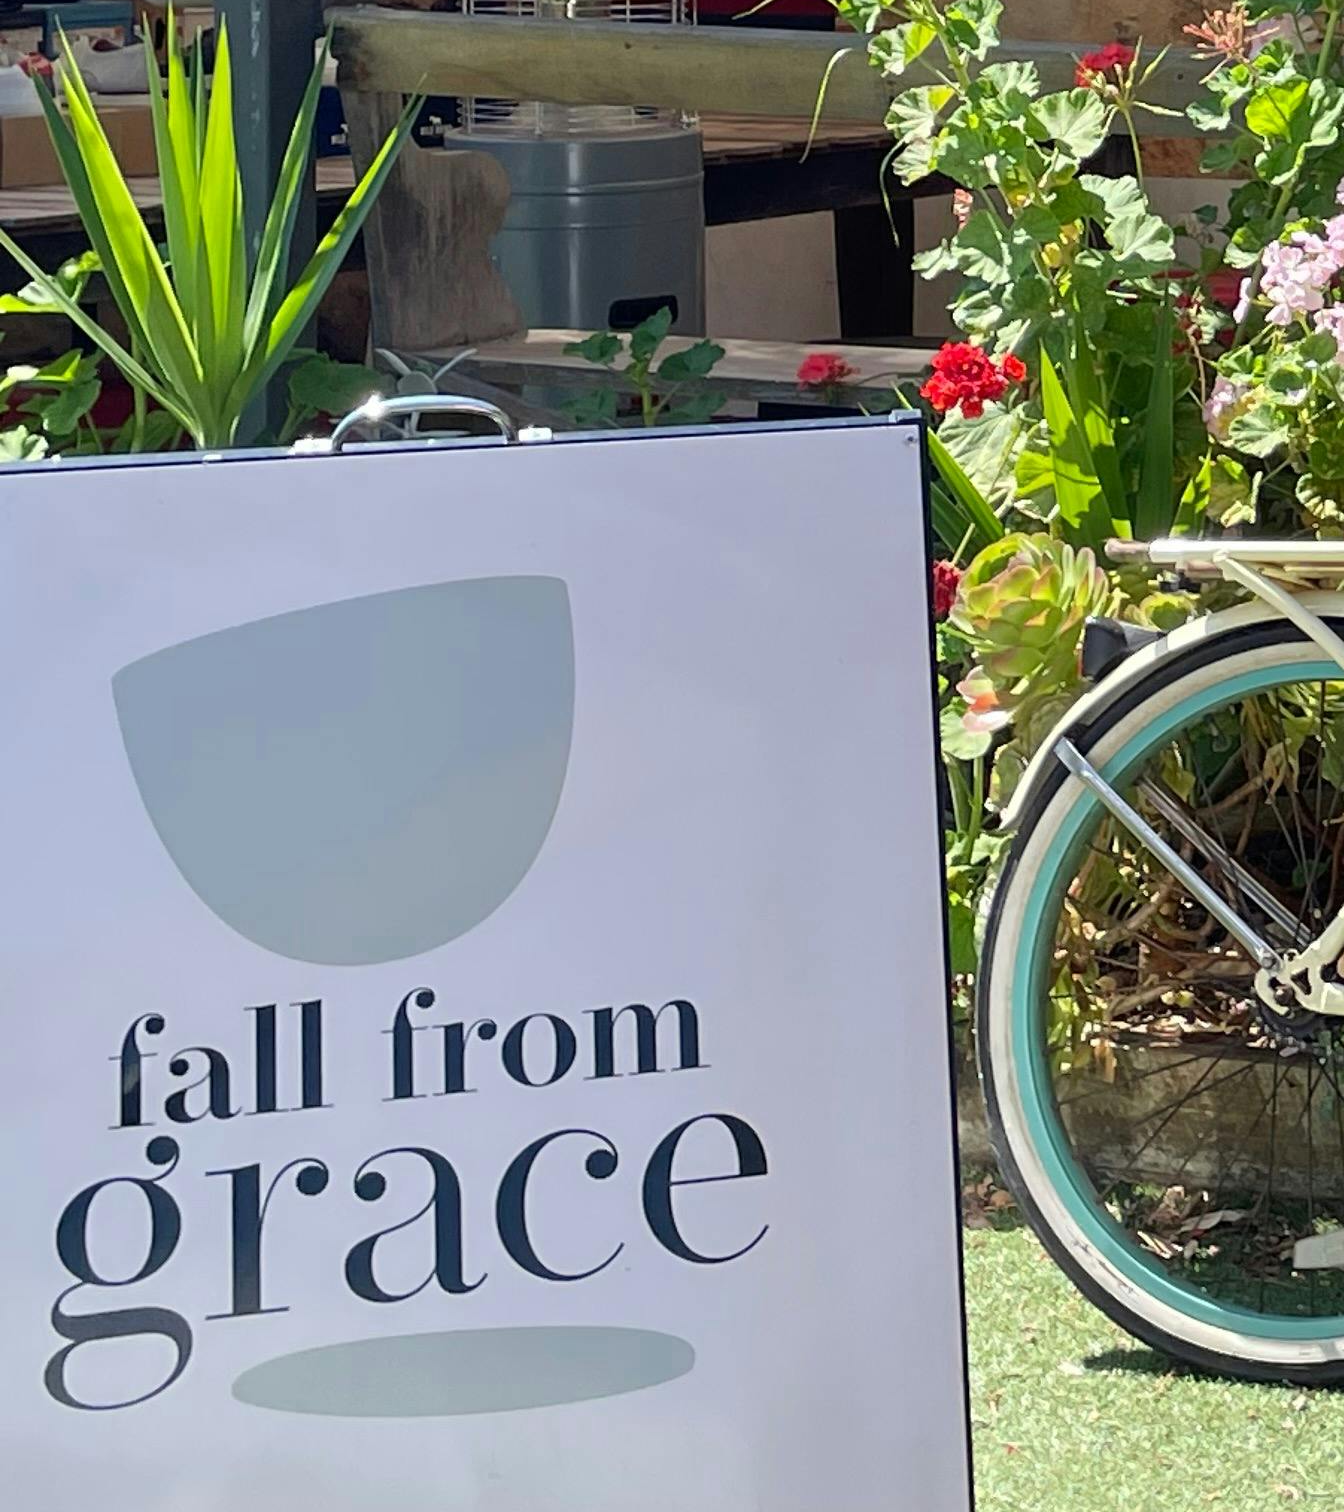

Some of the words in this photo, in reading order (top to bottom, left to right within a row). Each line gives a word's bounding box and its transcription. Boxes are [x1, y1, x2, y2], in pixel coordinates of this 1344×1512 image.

[107, 998, 335, 1131] fall
[380, 987, 712, 1101] from
[42, 1110, 772, 1412] grace
